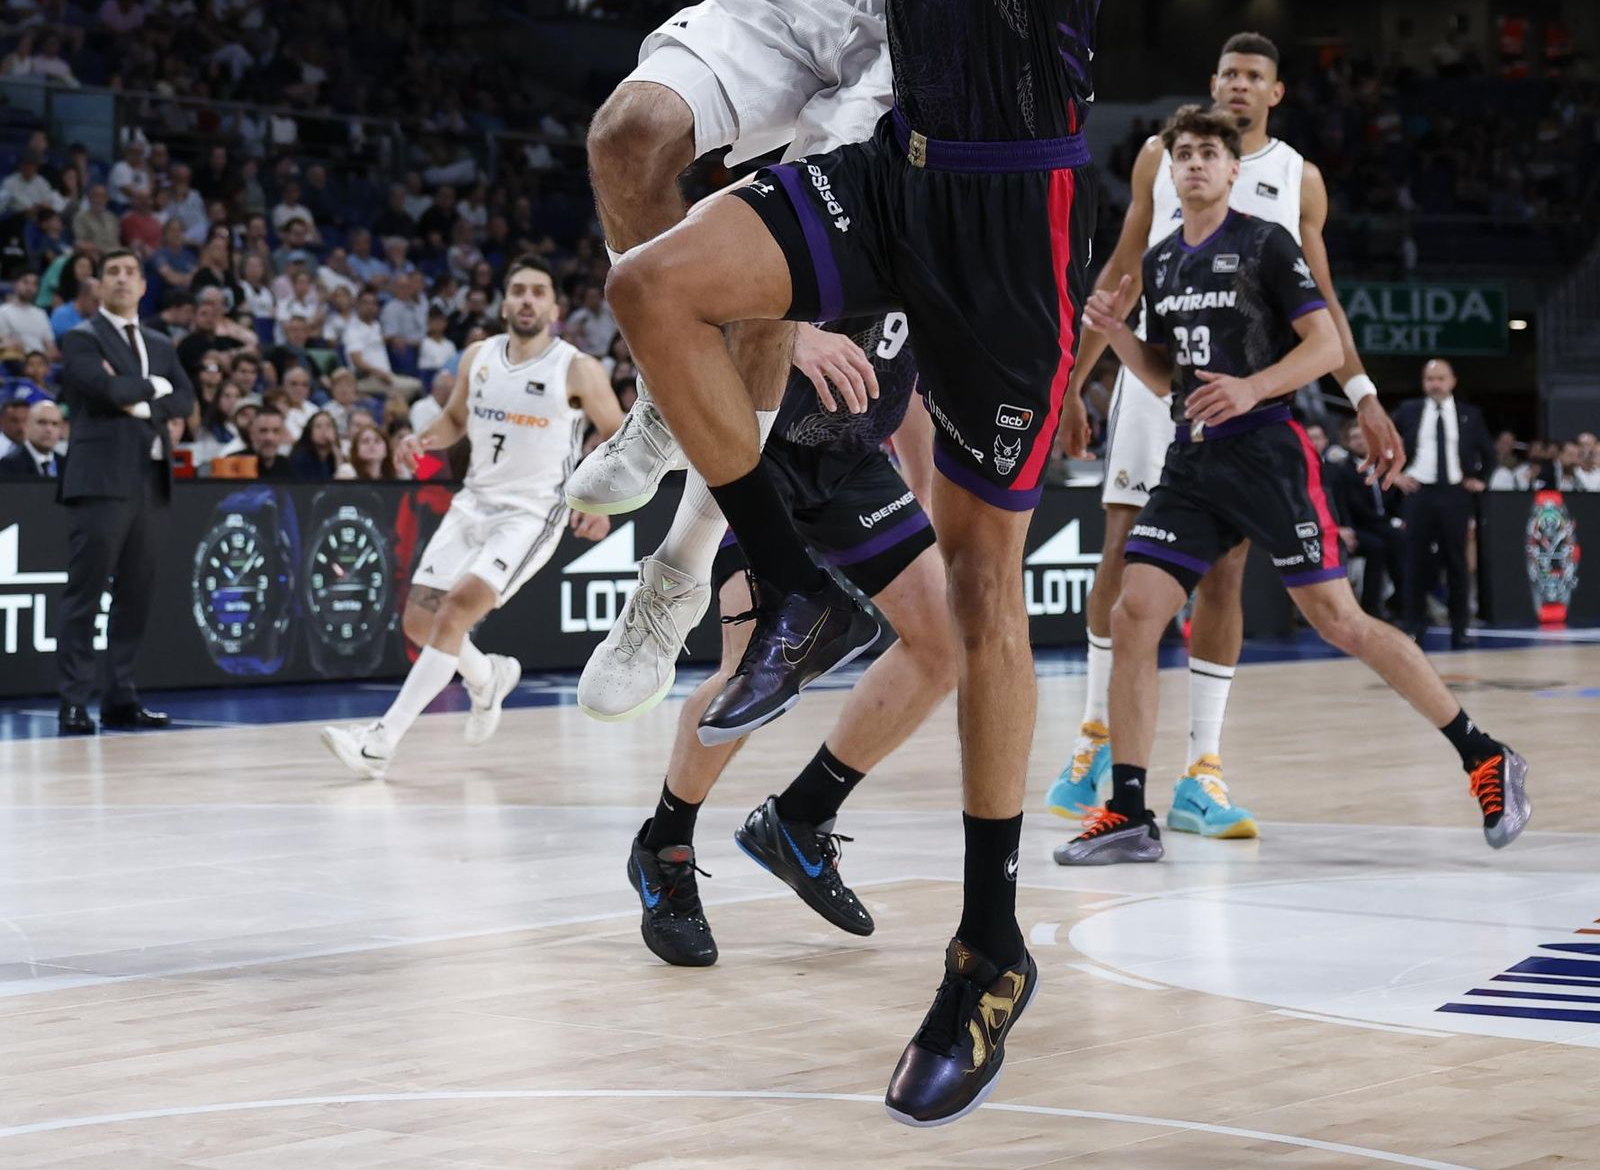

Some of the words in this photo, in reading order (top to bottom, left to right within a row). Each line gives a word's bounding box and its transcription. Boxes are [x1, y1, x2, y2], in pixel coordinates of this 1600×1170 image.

[1347, 285, 1493, 323] ALIDA
[876, 311, 909, 360] 9
[1173, 325, 1211, 367] 33
[1363, 324, 1444, 351] EXIT
[1000, 414, 1023, 427] acb
[491, 433, 507, 464] 7
[871, 491, 916, 522] BERNE
[560, 579, 641, 633] LOT
